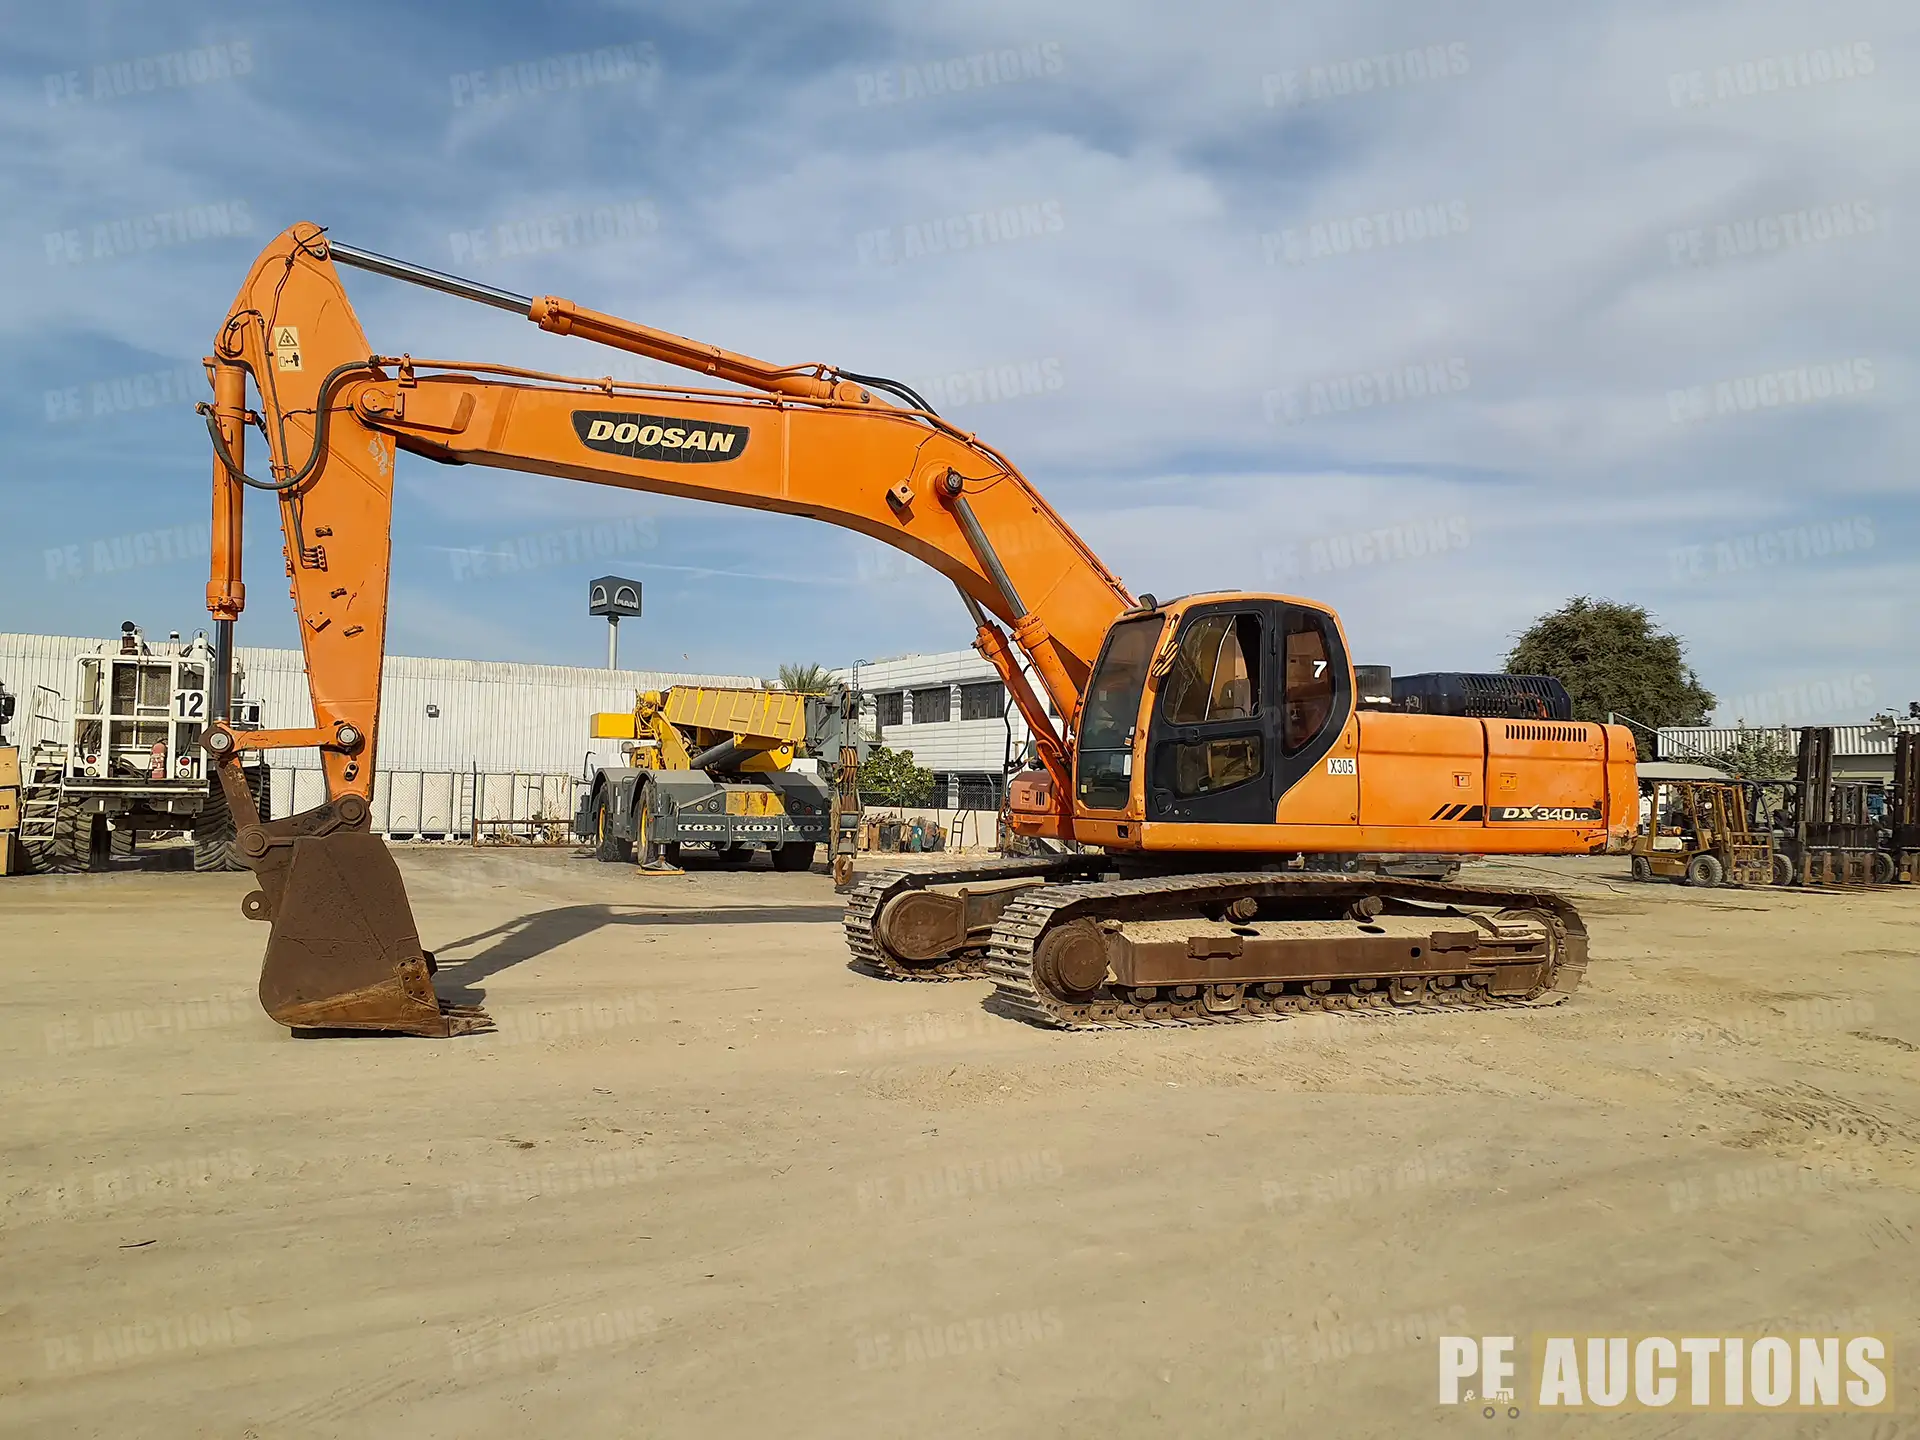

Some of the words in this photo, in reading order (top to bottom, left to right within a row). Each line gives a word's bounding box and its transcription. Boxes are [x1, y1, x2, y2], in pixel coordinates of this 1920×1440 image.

[587, 419, 736, 453] DOOSAN
[1312, 660, 1328, 679] 7
[174, 692, 204, 718] 12
[1329, 758, 1354, 775] X305
